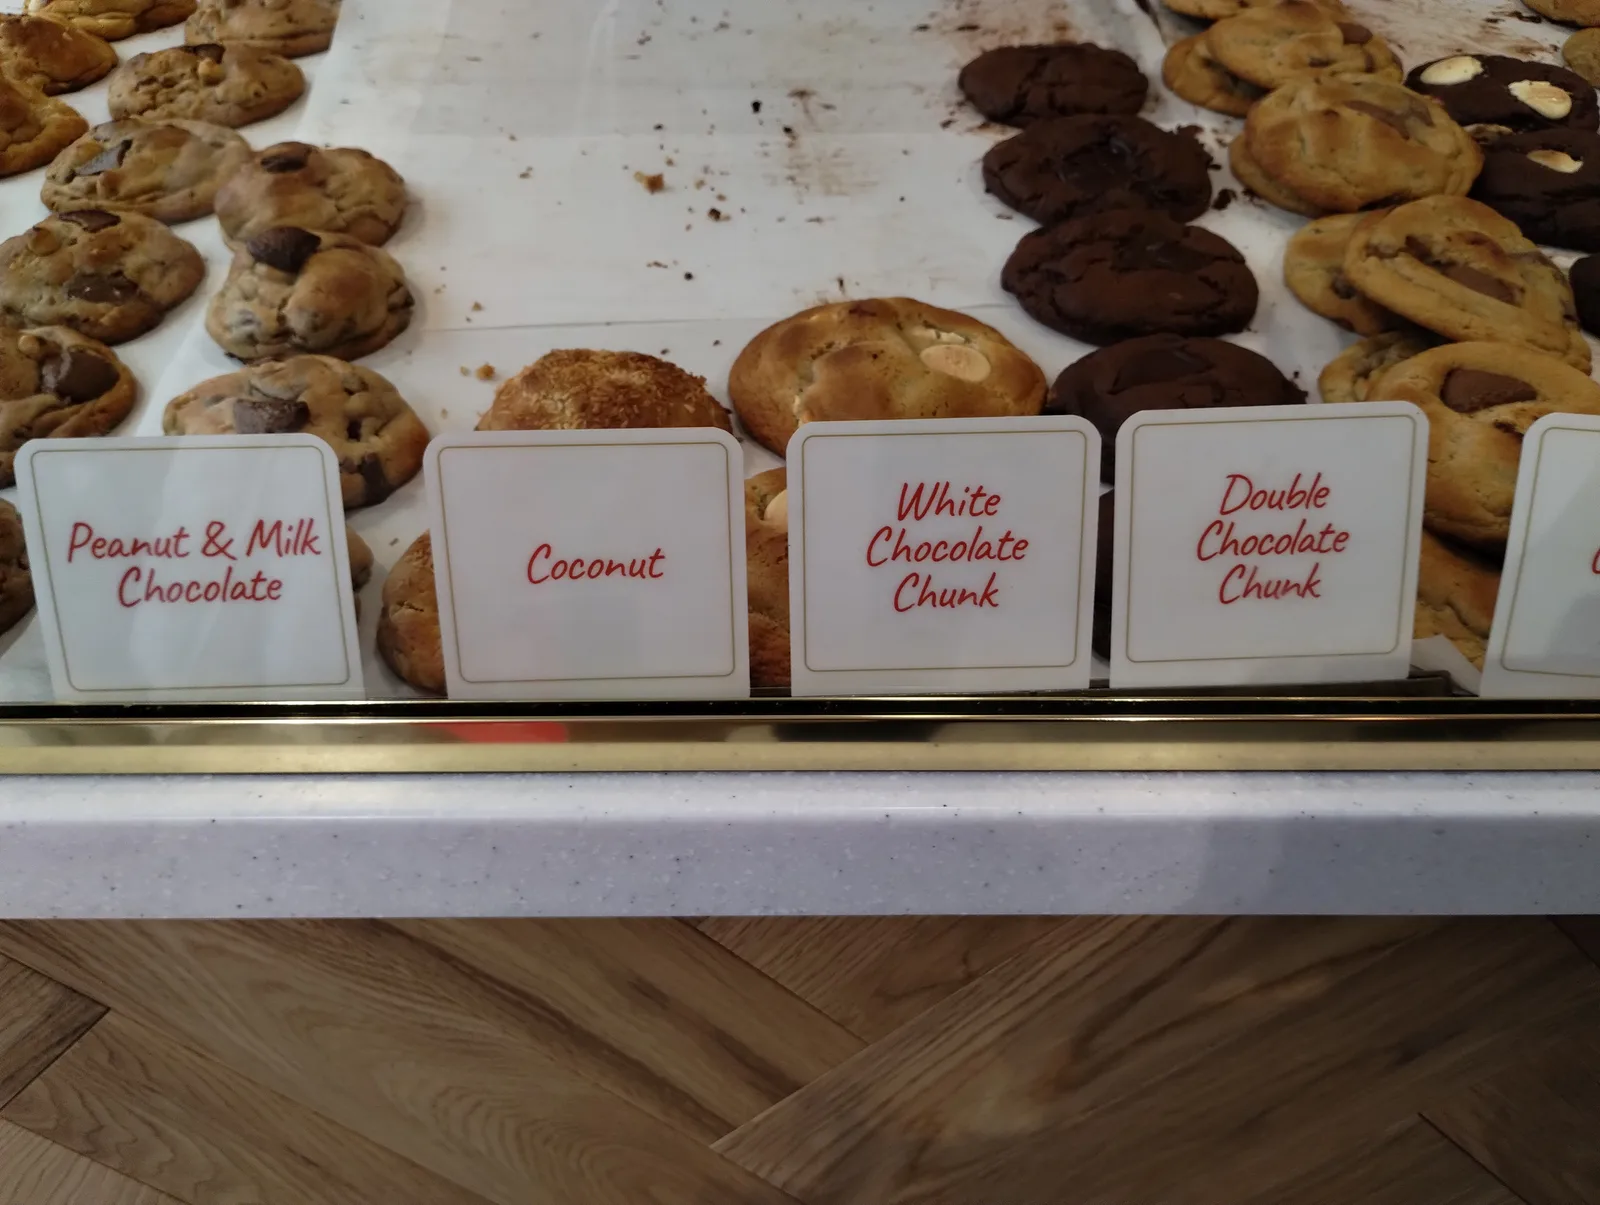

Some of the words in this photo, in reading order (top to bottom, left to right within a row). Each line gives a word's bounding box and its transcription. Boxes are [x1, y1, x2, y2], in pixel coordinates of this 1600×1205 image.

[897, 480, 1003, 522] White
[1218, 472, 1331, 516] Double
[67, 521, 189, 562] Peanut
[201, 520, 236, 561] &
[245, 518, 321, 559] Milk
[866, 525, 1030, 568] Chocolate
[1195, 518, 1351, 563] Chocolate
[526, 542, 666, 585] Coconut
[1218, 562, 1321, 605] Chunk
[118, 565, 282, 607] Chocolate
[893, 571, 1001, 613] Chunk
